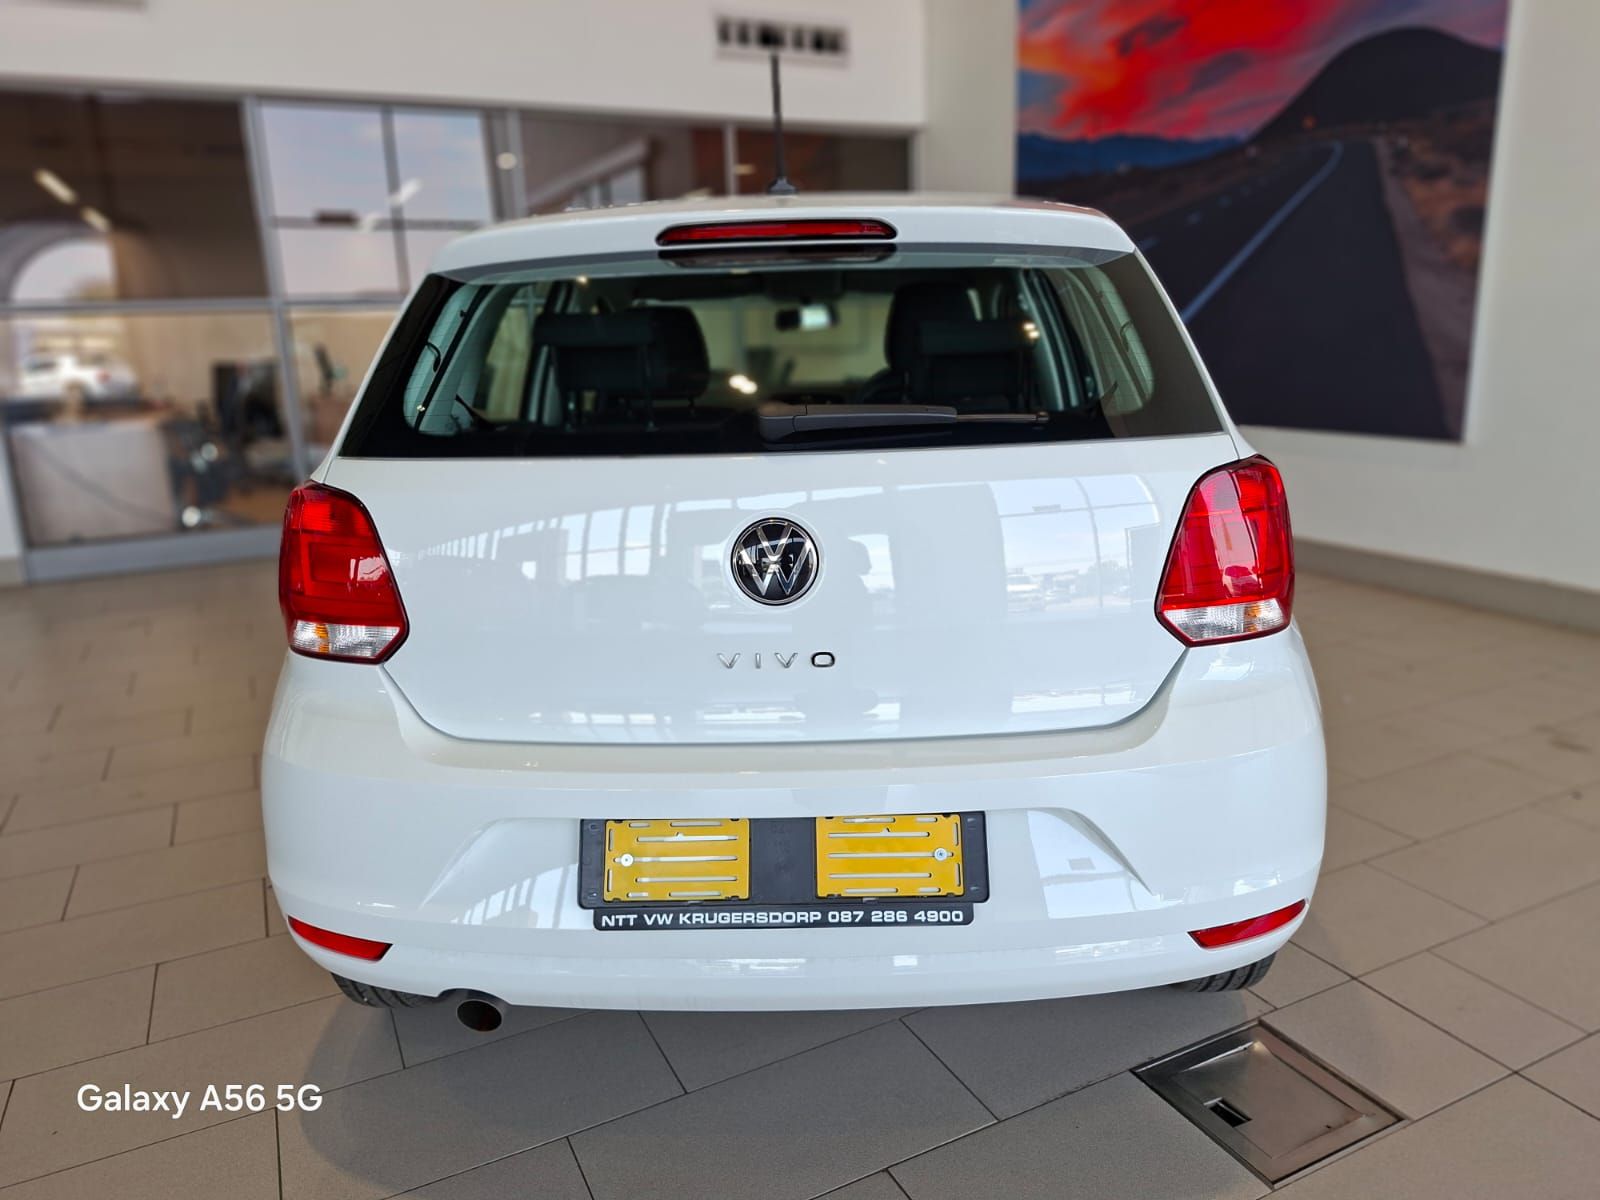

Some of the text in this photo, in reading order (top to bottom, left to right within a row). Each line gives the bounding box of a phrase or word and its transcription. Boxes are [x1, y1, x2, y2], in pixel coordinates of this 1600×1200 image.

[717, 652, 836, 669] VIVO
[601, 910, 964, 927] NTT VW KRUGERSDORP 087 286 4900
